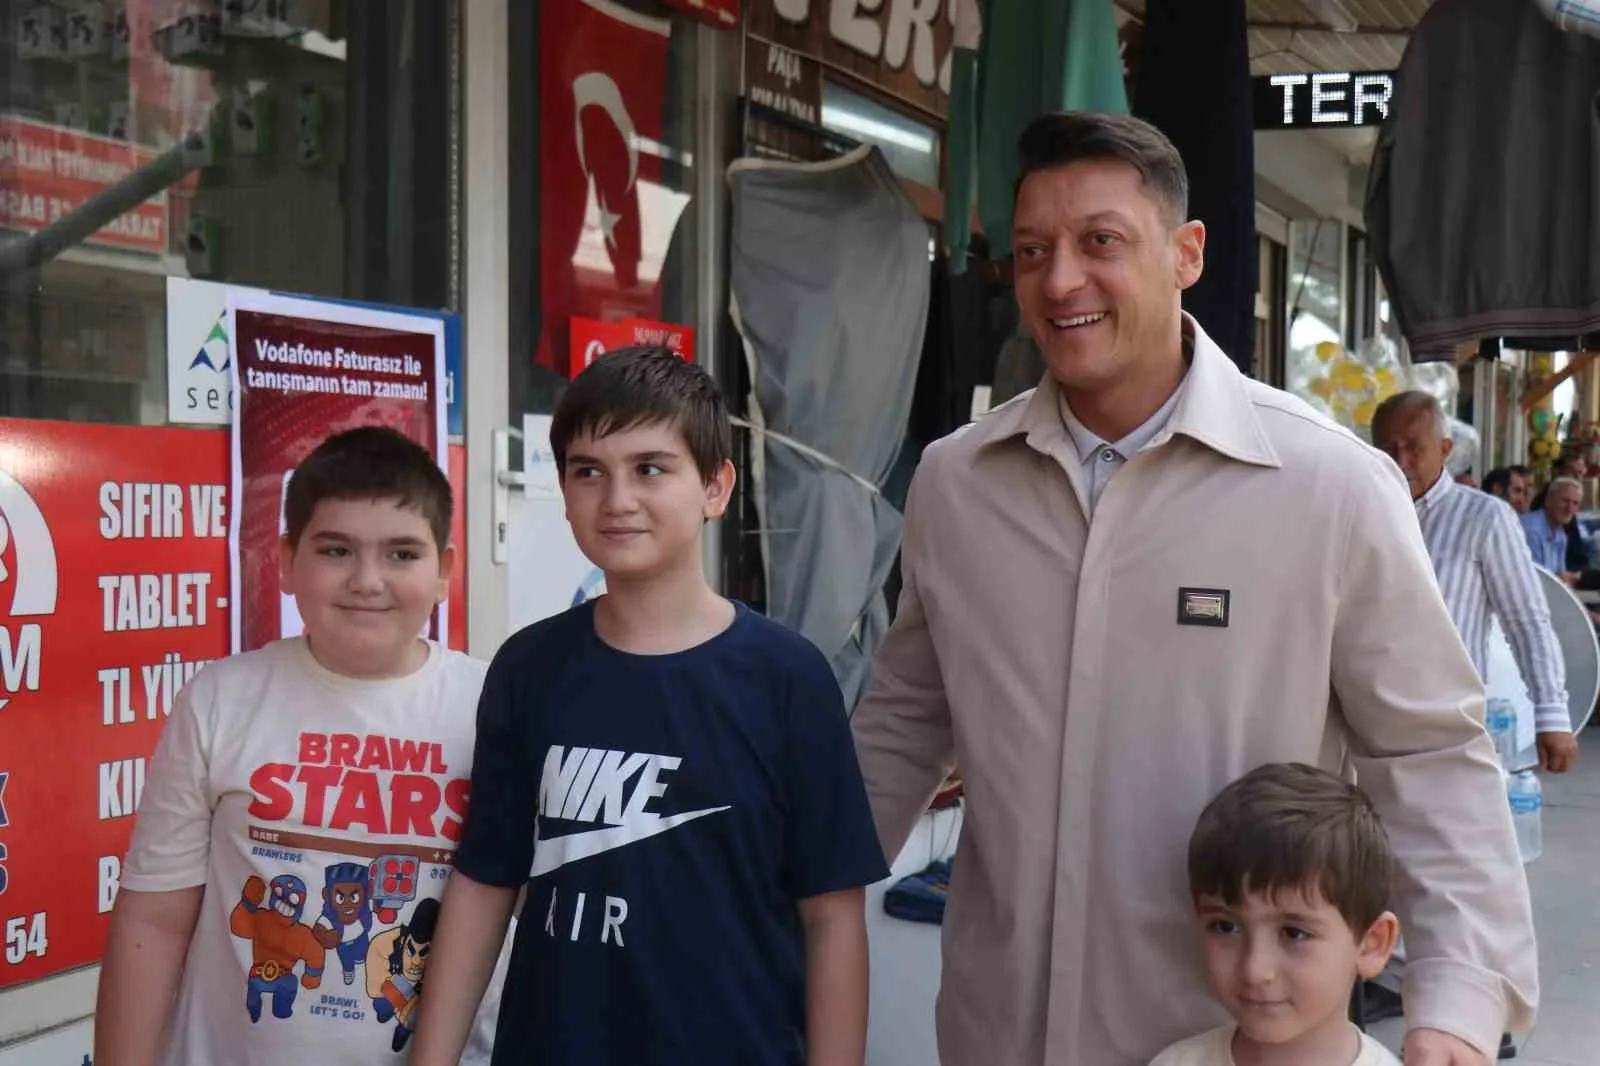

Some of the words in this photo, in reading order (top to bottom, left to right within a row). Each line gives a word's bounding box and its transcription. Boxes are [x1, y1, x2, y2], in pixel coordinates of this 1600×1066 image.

[774, 0, 952, 95] ER
[1270, 72, 1393, 125] TER
[247, 367, 340, 394] tanışmanın
[341, 373, 371, 395] tam
[373, 380, 428, 400] zamanı!
[255, 339, 333, 367] Vodafone
[334, 348, 401, 375] Faturasız
[403, 355, 422, 376] ile
[98, 480, 183, 540] SIFIR
[190, 484, 227, 538] VE
[98, 572, 211, 632] TABLET
[97, 667, 135, 725] TL
[298, 732, 448, 774] BRAWL
[248, 762, 473, 842] STARS
[538, 744, 683, 827] NIKE
[251, 846, 305, 865] BRAWLERS
[5, 911, 48, 965] 54
[545, 887, 629, 948] AIR
[310, 1004, 339, 1017] LET'S
[342, 1009, 365, 1021] GO!
[320, 994, 359, 1009] BRAWL
